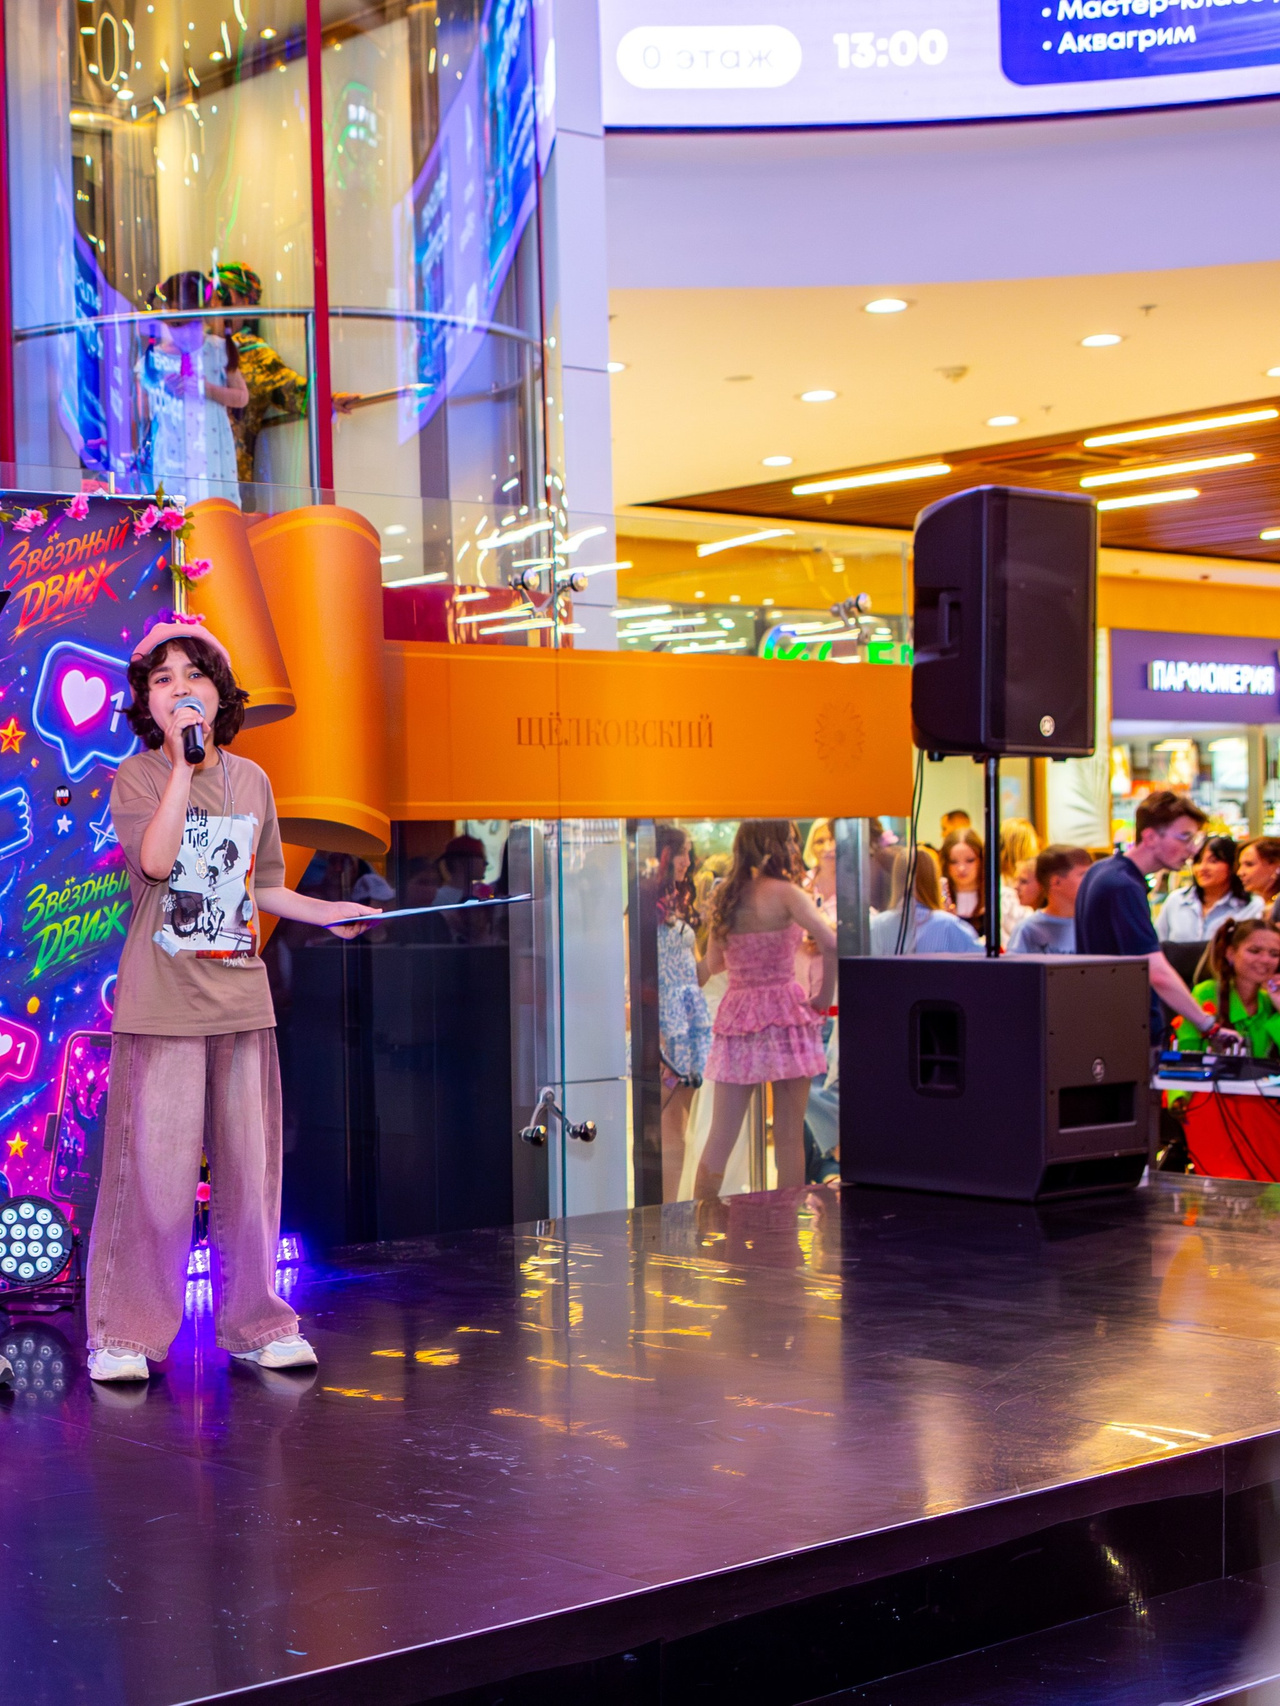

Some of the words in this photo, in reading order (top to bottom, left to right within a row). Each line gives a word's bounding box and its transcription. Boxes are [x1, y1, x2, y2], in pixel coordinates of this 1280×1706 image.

[833, 28, 949, 69] 13:00
[1057, 25, 1197, 54] Аквагрим
[676, 49, 774, 70] этаж
[1150, 660, 1276, 695] ПАРФЮМЕРИЯ
[109, 690, 125, 733] 1
[516, 711, 713, 750] ЩЁЛКОВСКИЙ
[16, 1041, 27, 1065] 1
